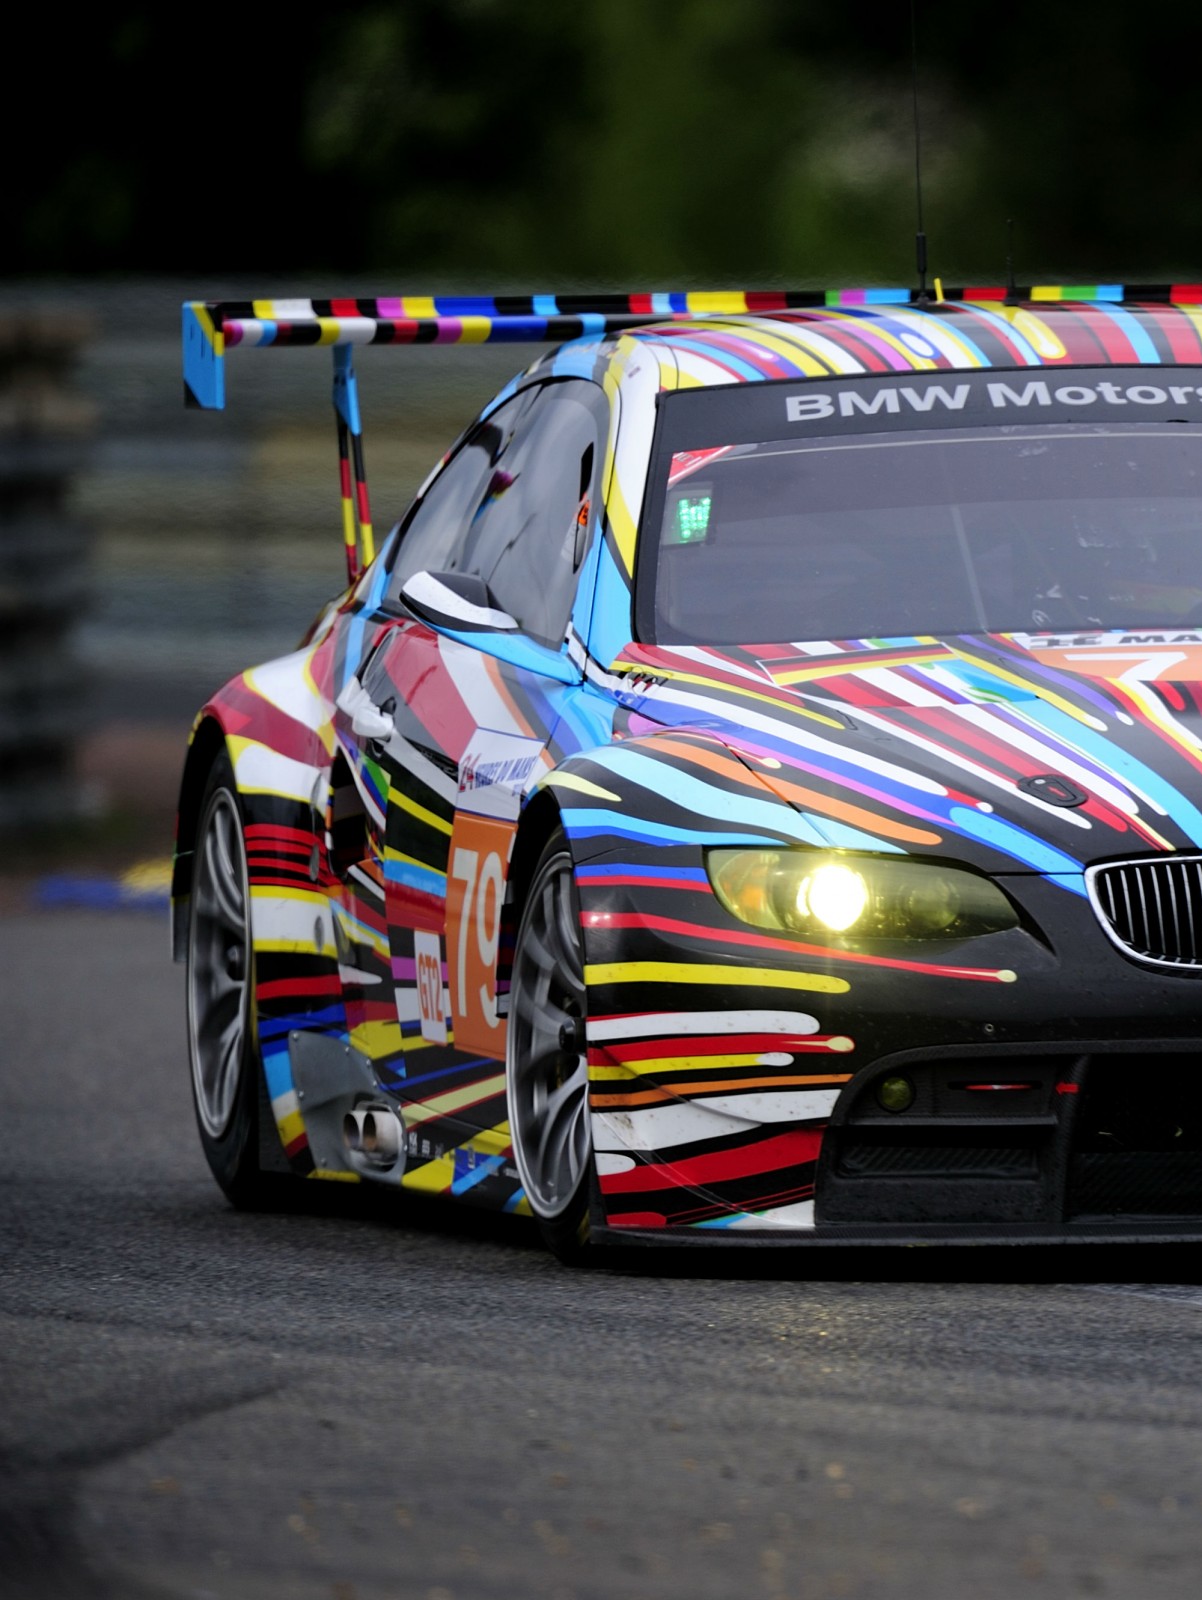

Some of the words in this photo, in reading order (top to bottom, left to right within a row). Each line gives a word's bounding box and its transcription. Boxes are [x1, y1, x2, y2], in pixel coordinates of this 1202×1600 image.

[786, 383, 970, 422] BMW
[459, 753, 481, 793] 24
[452, 847, 503, 1028] 79
[418, 952, 443, 1022] GT2
